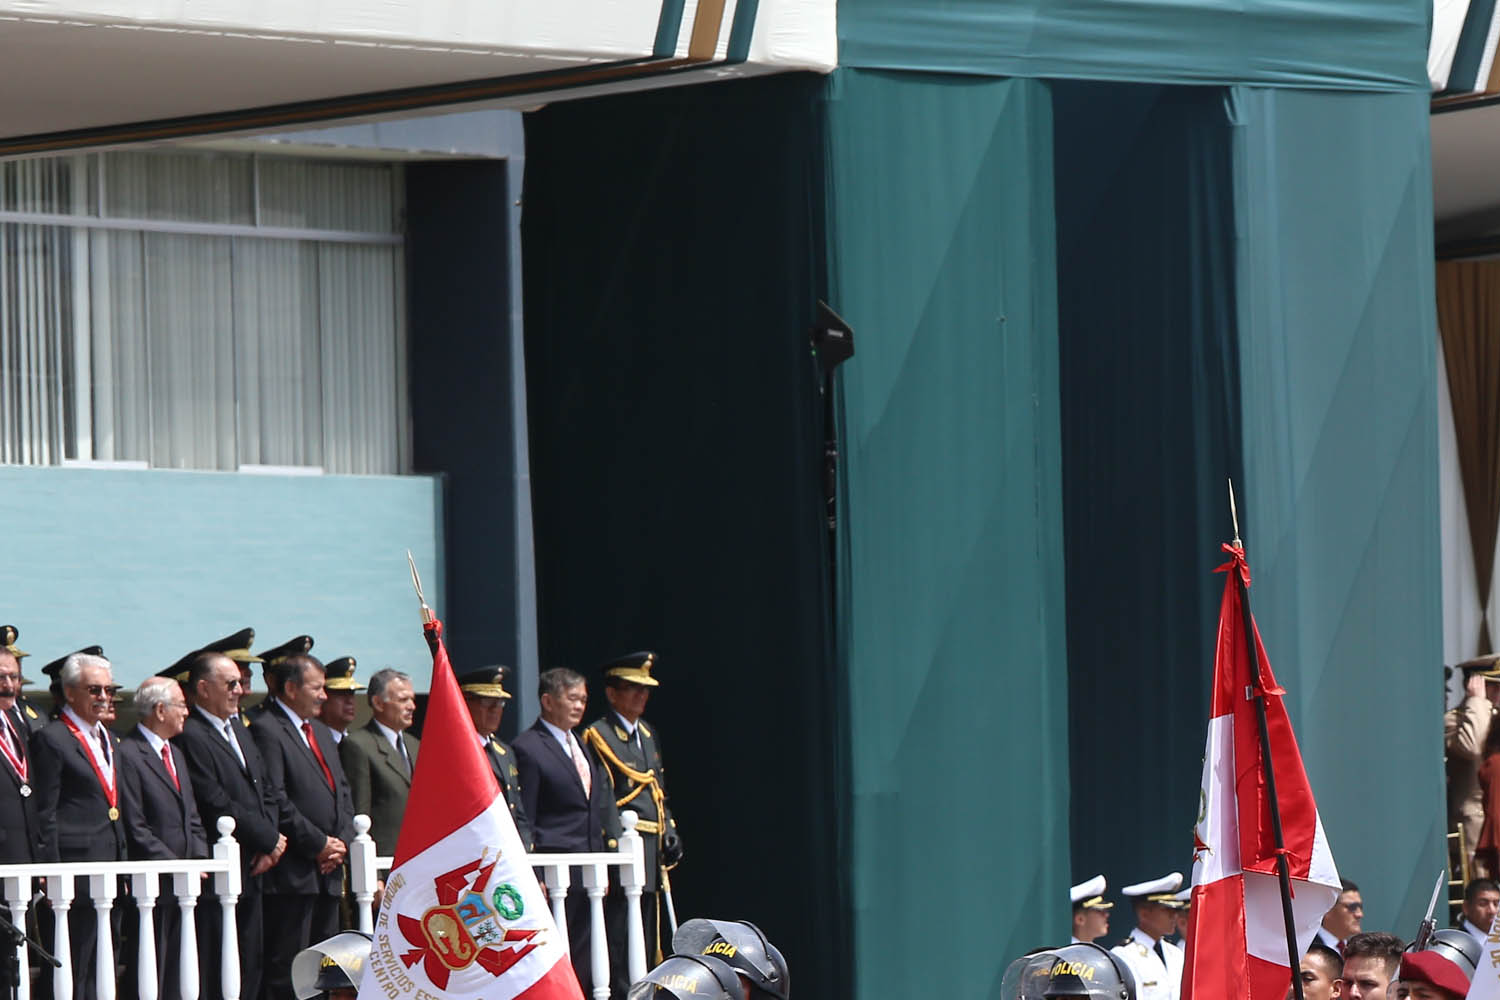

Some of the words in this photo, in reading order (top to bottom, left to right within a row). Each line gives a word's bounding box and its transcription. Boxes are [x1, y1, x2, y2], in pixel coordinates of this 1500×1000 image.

[379, 912, 389, 929] DE
[369, 951, 400, 1000] CENTRO
[379, 934, 415, 993] SERVICIOS
